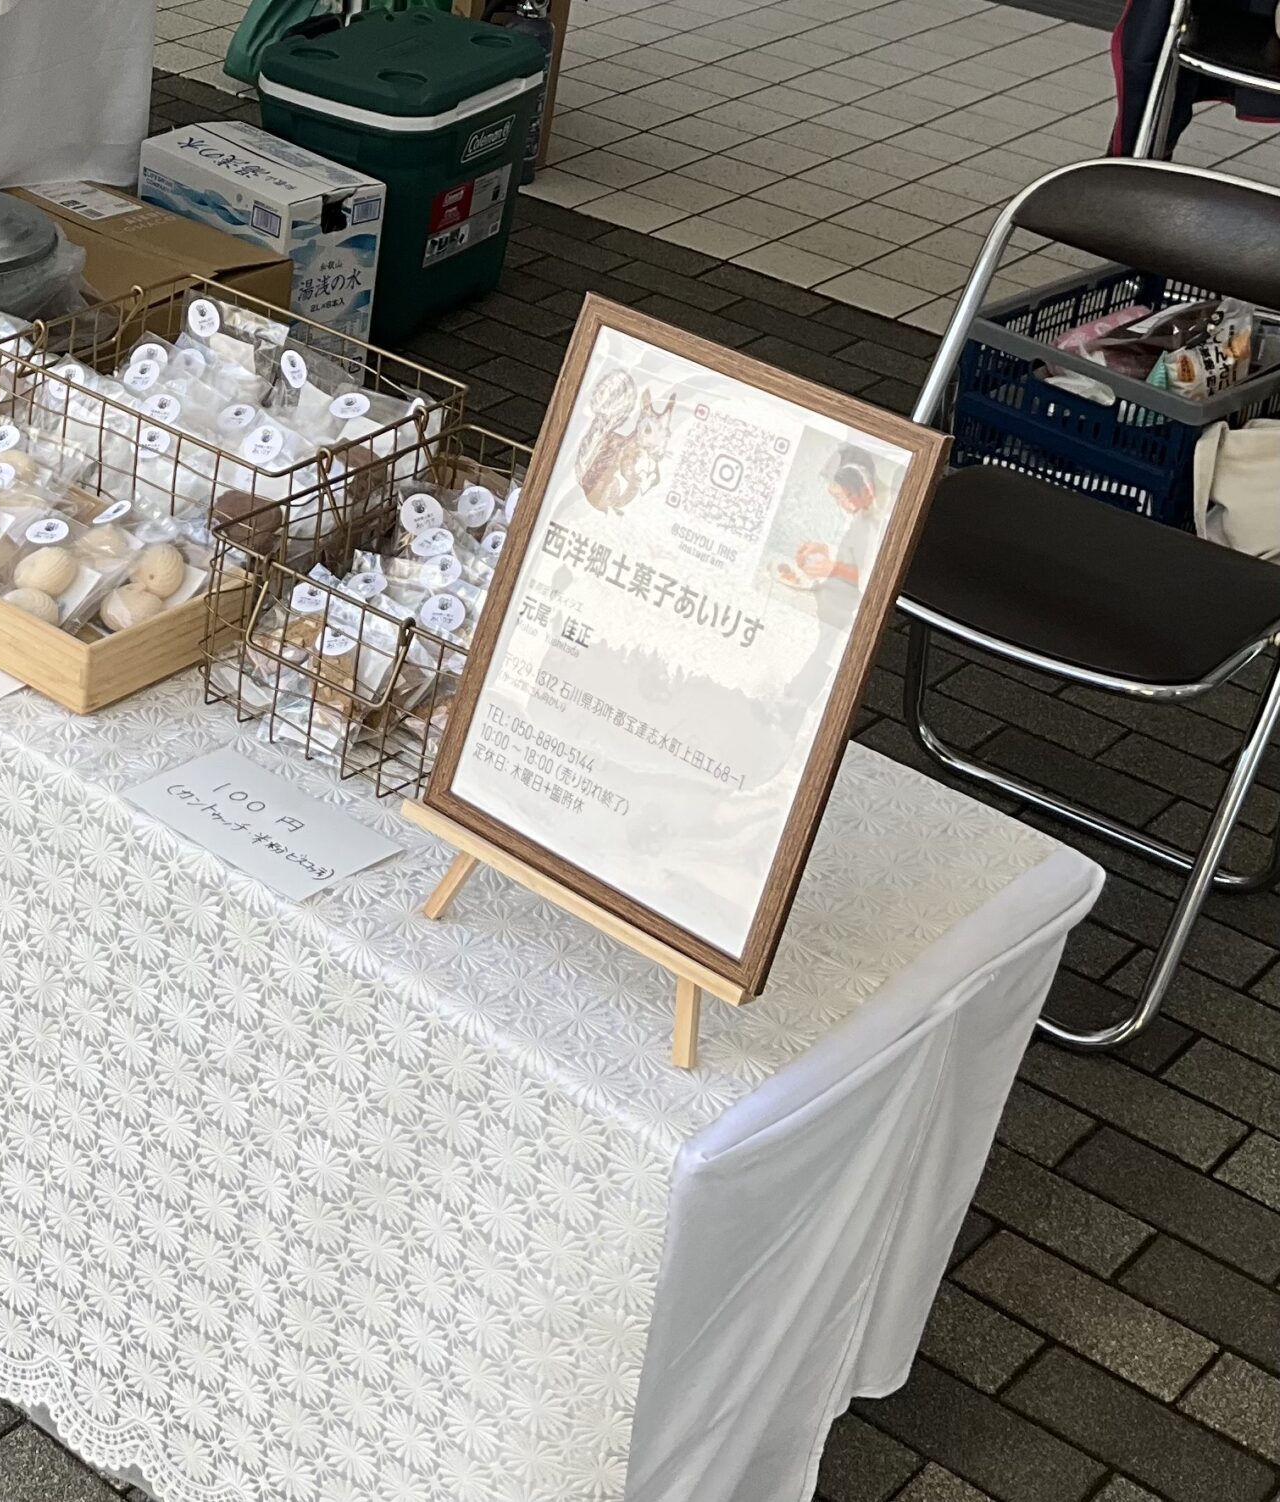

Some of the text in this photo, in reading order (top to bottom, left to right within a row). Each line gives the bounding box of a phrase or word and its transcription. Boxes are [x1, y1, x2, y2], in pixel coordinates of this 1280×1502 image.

[468, 125, 503, 153] Coleman
[297, 269, 362, 302] 湯浅の水
[542, 521, 765, 648] 西洋郷土菓子あいりす
[472, 742, 509, 772] 定休日:
[480, 722, 510, 751] 10:00
[523, 746, 554, 775] 18:00
[487, 703, 596, 774] TEL: 050-8890-5144
[212, 782, 305, 833] 100円
